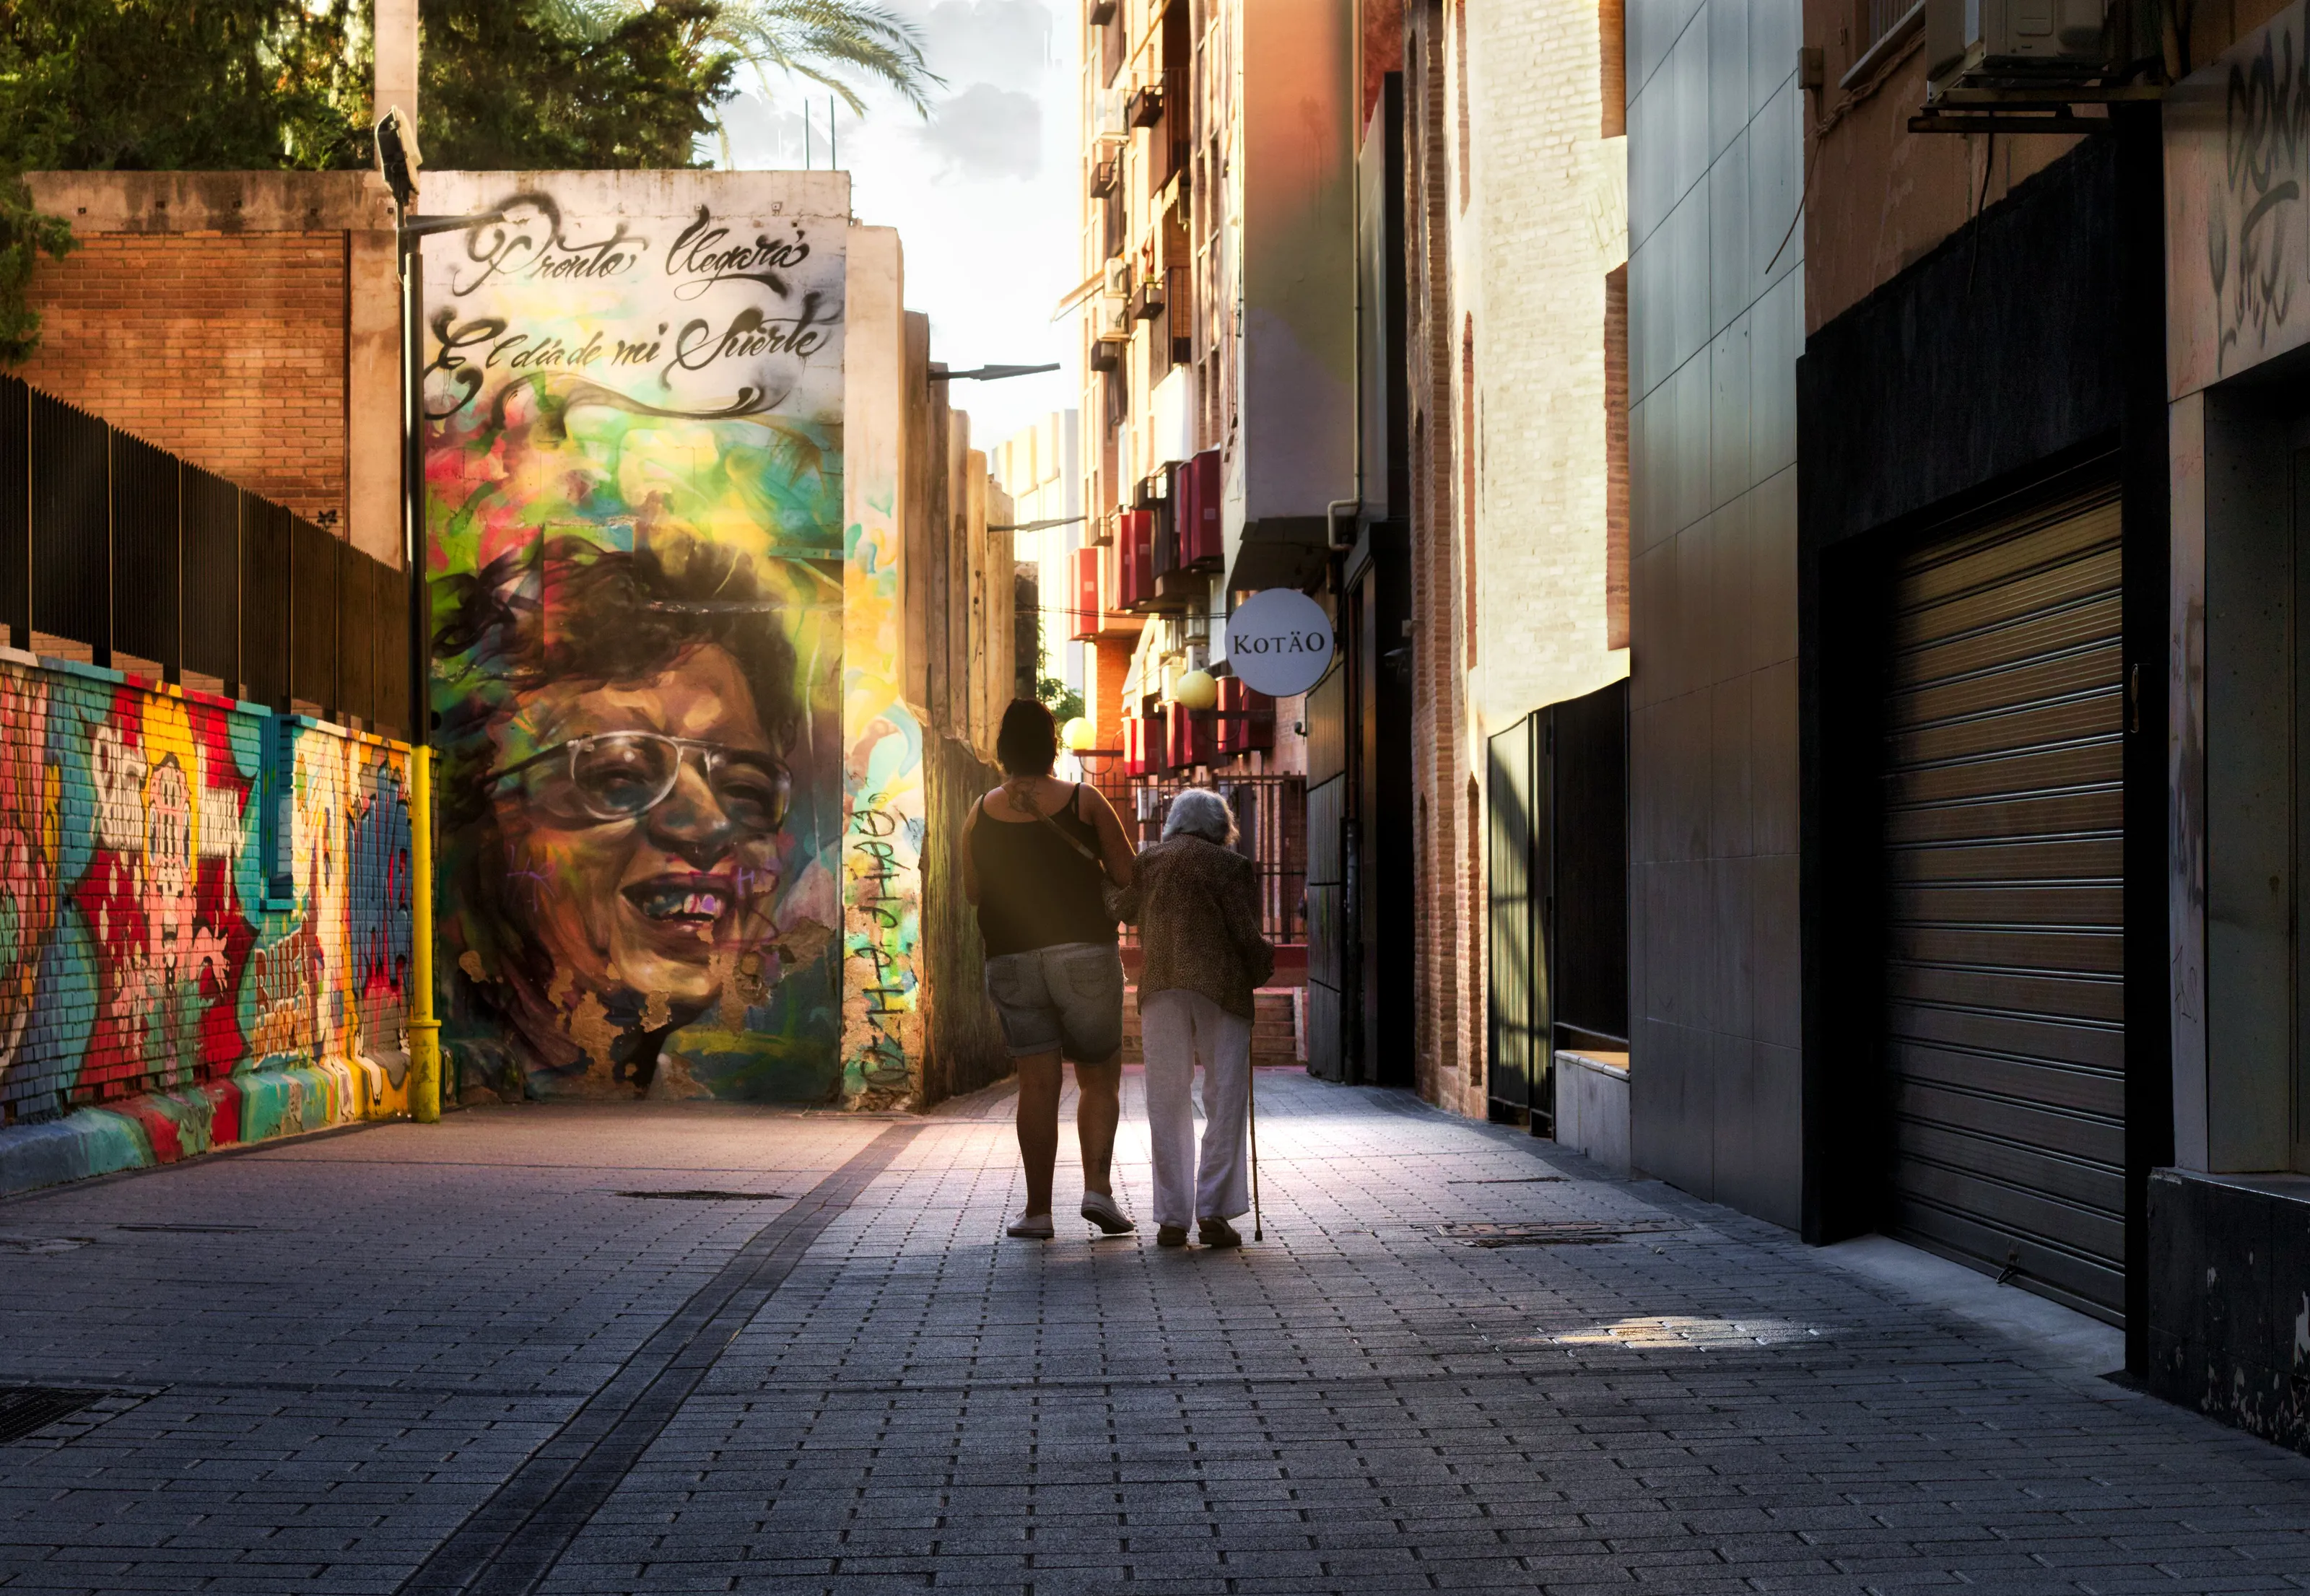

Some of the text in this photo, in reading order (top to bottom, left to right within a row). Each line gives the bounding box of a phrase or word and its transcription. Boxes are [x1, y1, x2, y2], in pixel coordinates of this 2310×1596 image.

[452, 191, 648, 297] Pronto
[566, 330, 601, 367] de
[610, 321, 668, 367] mi
